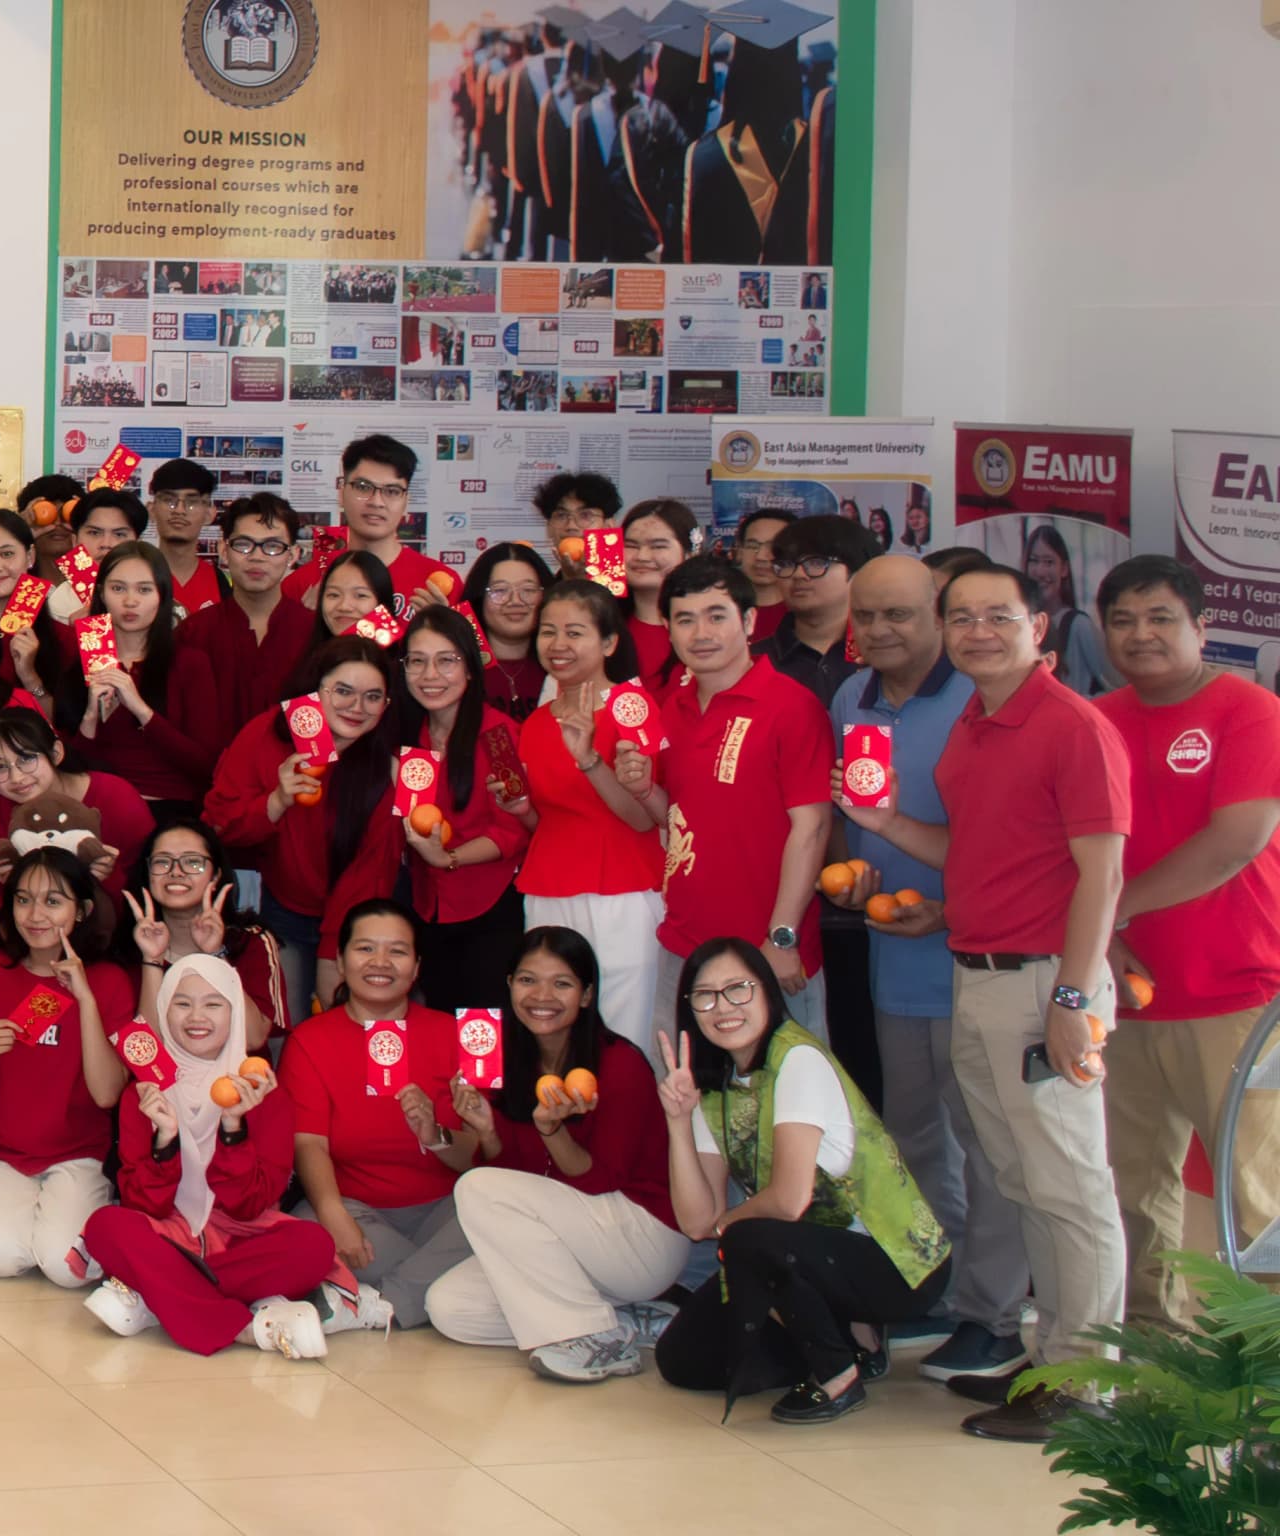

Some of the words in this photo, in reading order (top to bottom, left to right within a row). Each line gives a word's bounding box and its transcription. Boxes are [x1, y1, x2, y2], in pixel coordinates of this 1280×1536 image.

[183, 130, 223, 146] OUR
[229, 131, 307, 147] MISSION
[118, 153, 197, 170] Delivering
[201, 156, 255, 171] degree
[259, 158, 332, 173] programs
[336, 159, 365, 173] and
[123, 176, 217, 193] professional
[222, 180, 280, 193] courses
[284, 180, 330, 194] which
[335, 184, 359, 195] are
[127, 199, 240, 217] internationally
[244, 202, 328, 218] recognised
[333, 203, 355, 217] for
[87, 222, 167, 238] producing
[171, 223, 316, 240] employment-ready
[320, 227, 396, 241] graduates
[764, 442, 784, 452] East
[786, 442, 808, 453] Asia
[809, 442, 873, 454] Management
[875, 443, 925, 455] University
[291, 460, 322, 473] GKL
[764, 458, 777, 467] Top
[778, 458, 824, 467] Management
[826, 458, 849, 466] School
[1022, 446, 1117, 484] EAMU
[463, 481, 485, 491] 2012
[1212, 452, 1280, 503] EA
[1243, 526, 1280, 541] Innova
[442, 553, 464, 563] 2013
[1231, 583, 1241, 598] 4
[1242, 611, 1280, 629] Quali
